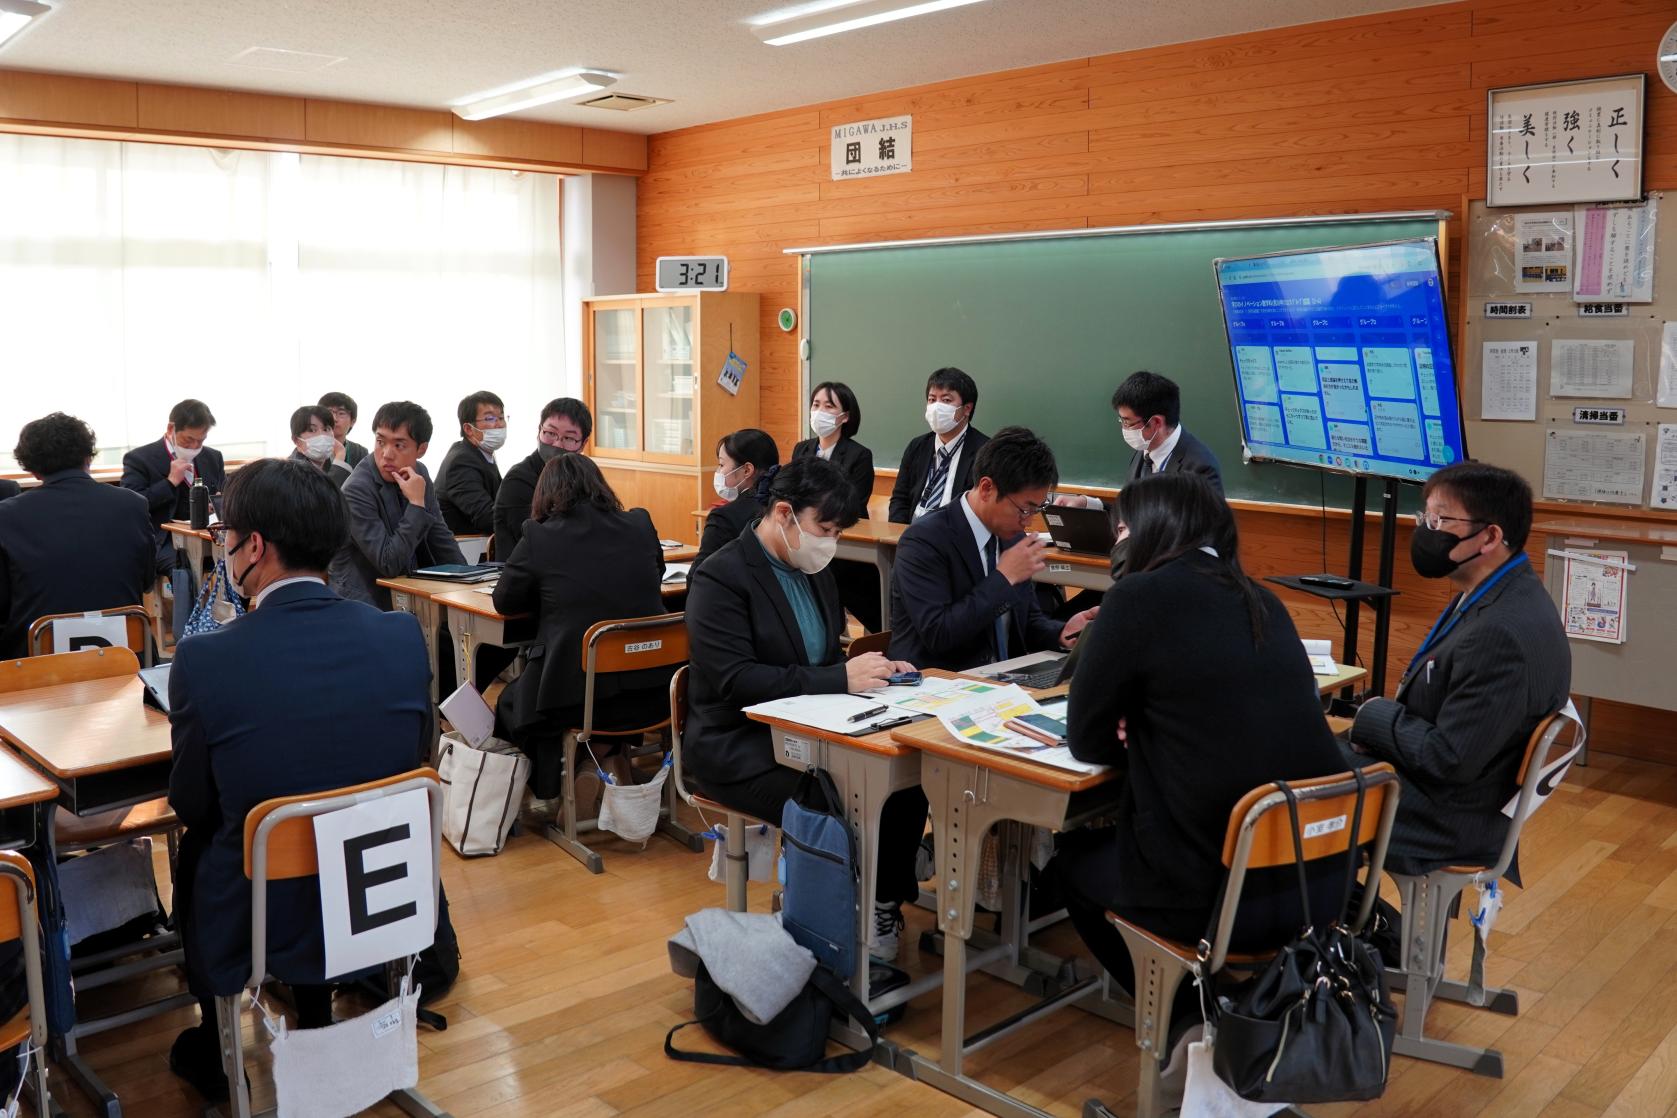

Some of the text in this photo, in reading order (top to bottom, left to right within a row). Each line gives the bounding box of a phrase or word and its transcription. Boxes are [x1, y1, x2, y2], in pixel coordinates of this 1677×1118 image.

[834, 122, 877, 140] MIGAWA
[1563, 109, 1580, 155] 強く
[1607, 106, 1628, 179] 正しく
[1519, 112, 1536, 184] 美しく
[679, 262, 720, 285] 3:21
[1489, 305, 1527, 315] 時間割表
[1583, 303, 1623, 314] 給食当番
[1580, 410, 1619, 421] 清掃当番
[343, 822, 417, 936] E
